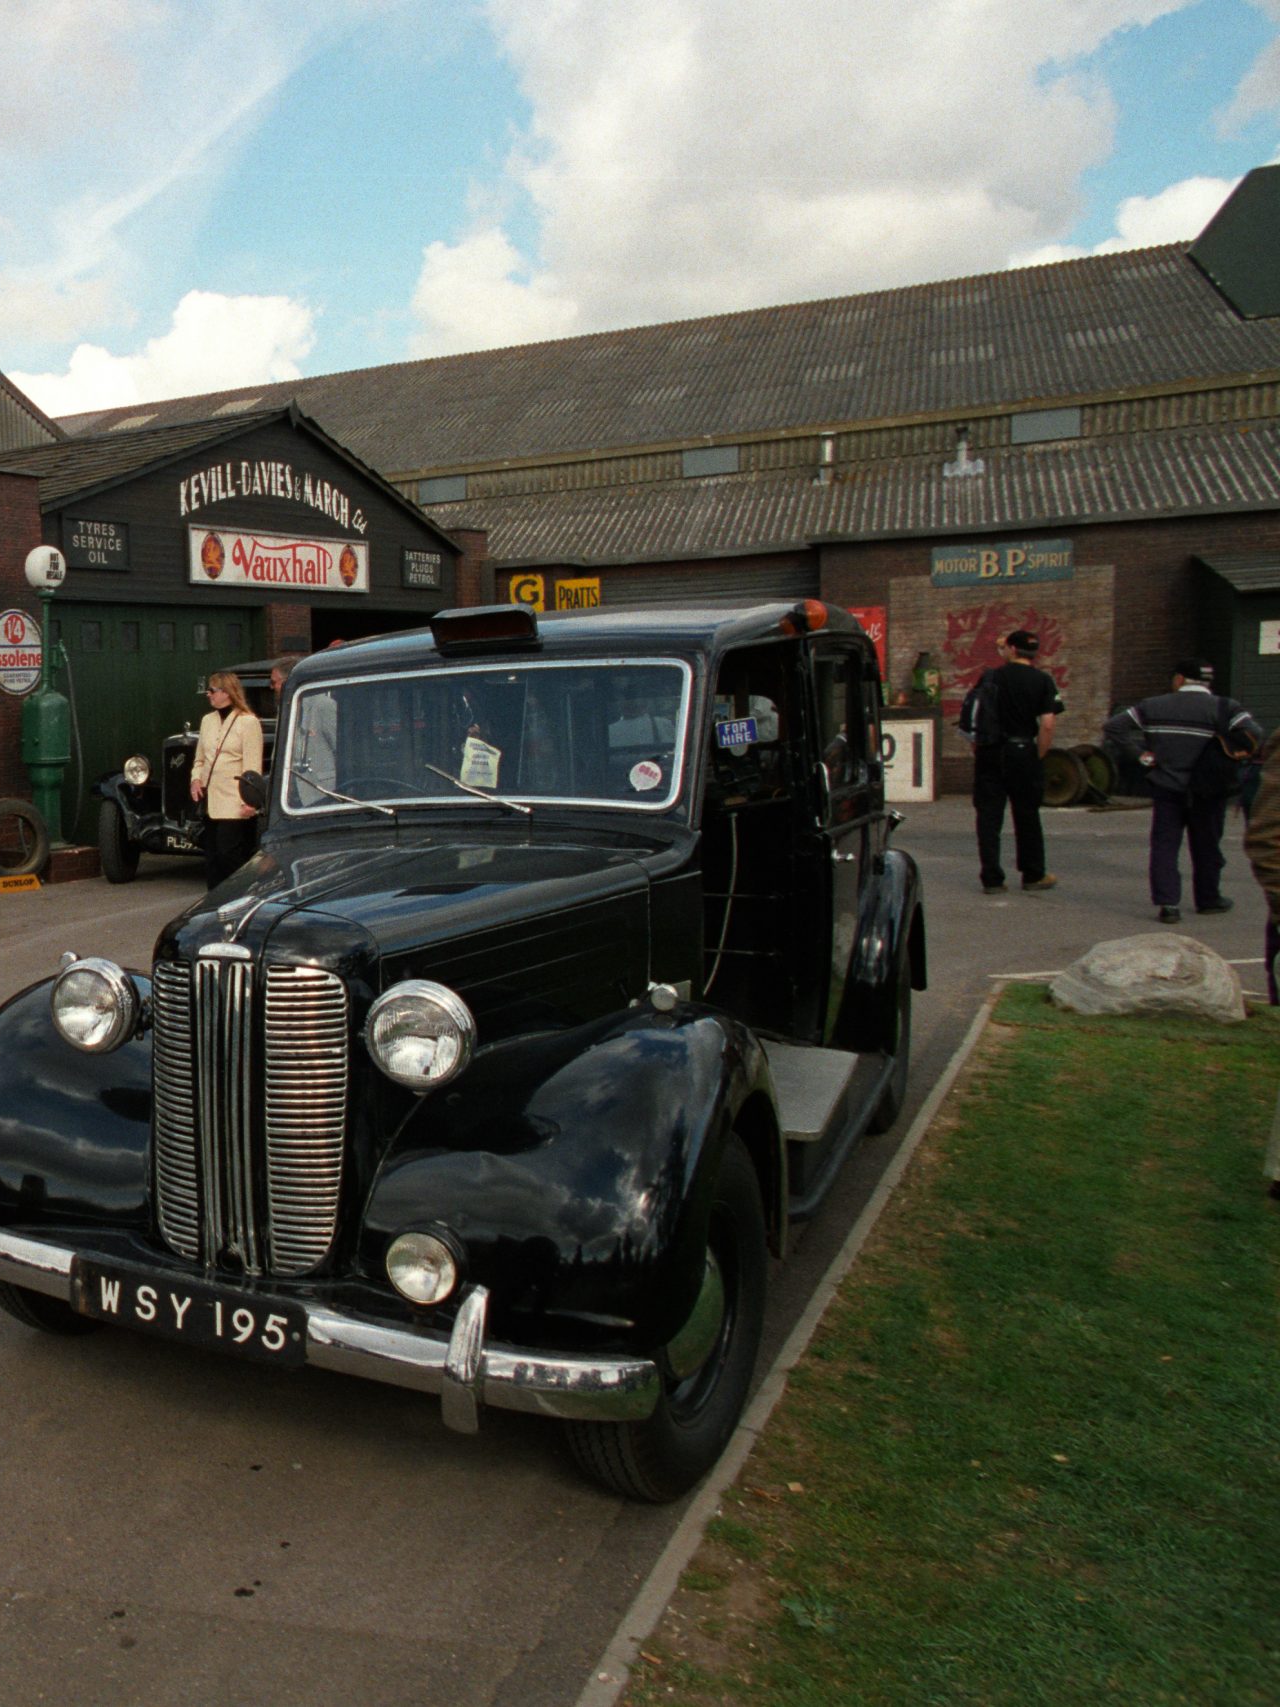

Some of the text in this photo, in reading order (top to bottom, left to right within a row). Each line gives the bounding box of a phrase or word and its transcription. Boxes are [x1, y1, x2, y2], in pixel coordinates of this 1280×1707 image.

[180, 461, 293, 517] KEVILL-DAVIES
[303, 472, 349, 529] MARCH
[78, 521, 116, 536] TYRES
[72, 534, 122, 551] SERVICE
[88, 551, 108, 564] OIL
[231, 536, 333, 585] Vauxhall
[404, 550, 441, 564] BATTERIES
[933, 558, 978, 574] MOTOR
[1028, 551, 1070, 569] SPIRIT
[411, 562, 434, 573] PLUGS
[409, 573, 435, 585] PETROL
[558, 585, 599, 611] PRATTS
[723, 721, 748, 734] FOR
[722, 731, 753, 746] HIRE
[1, 878, 35, 888] DUNLOP
